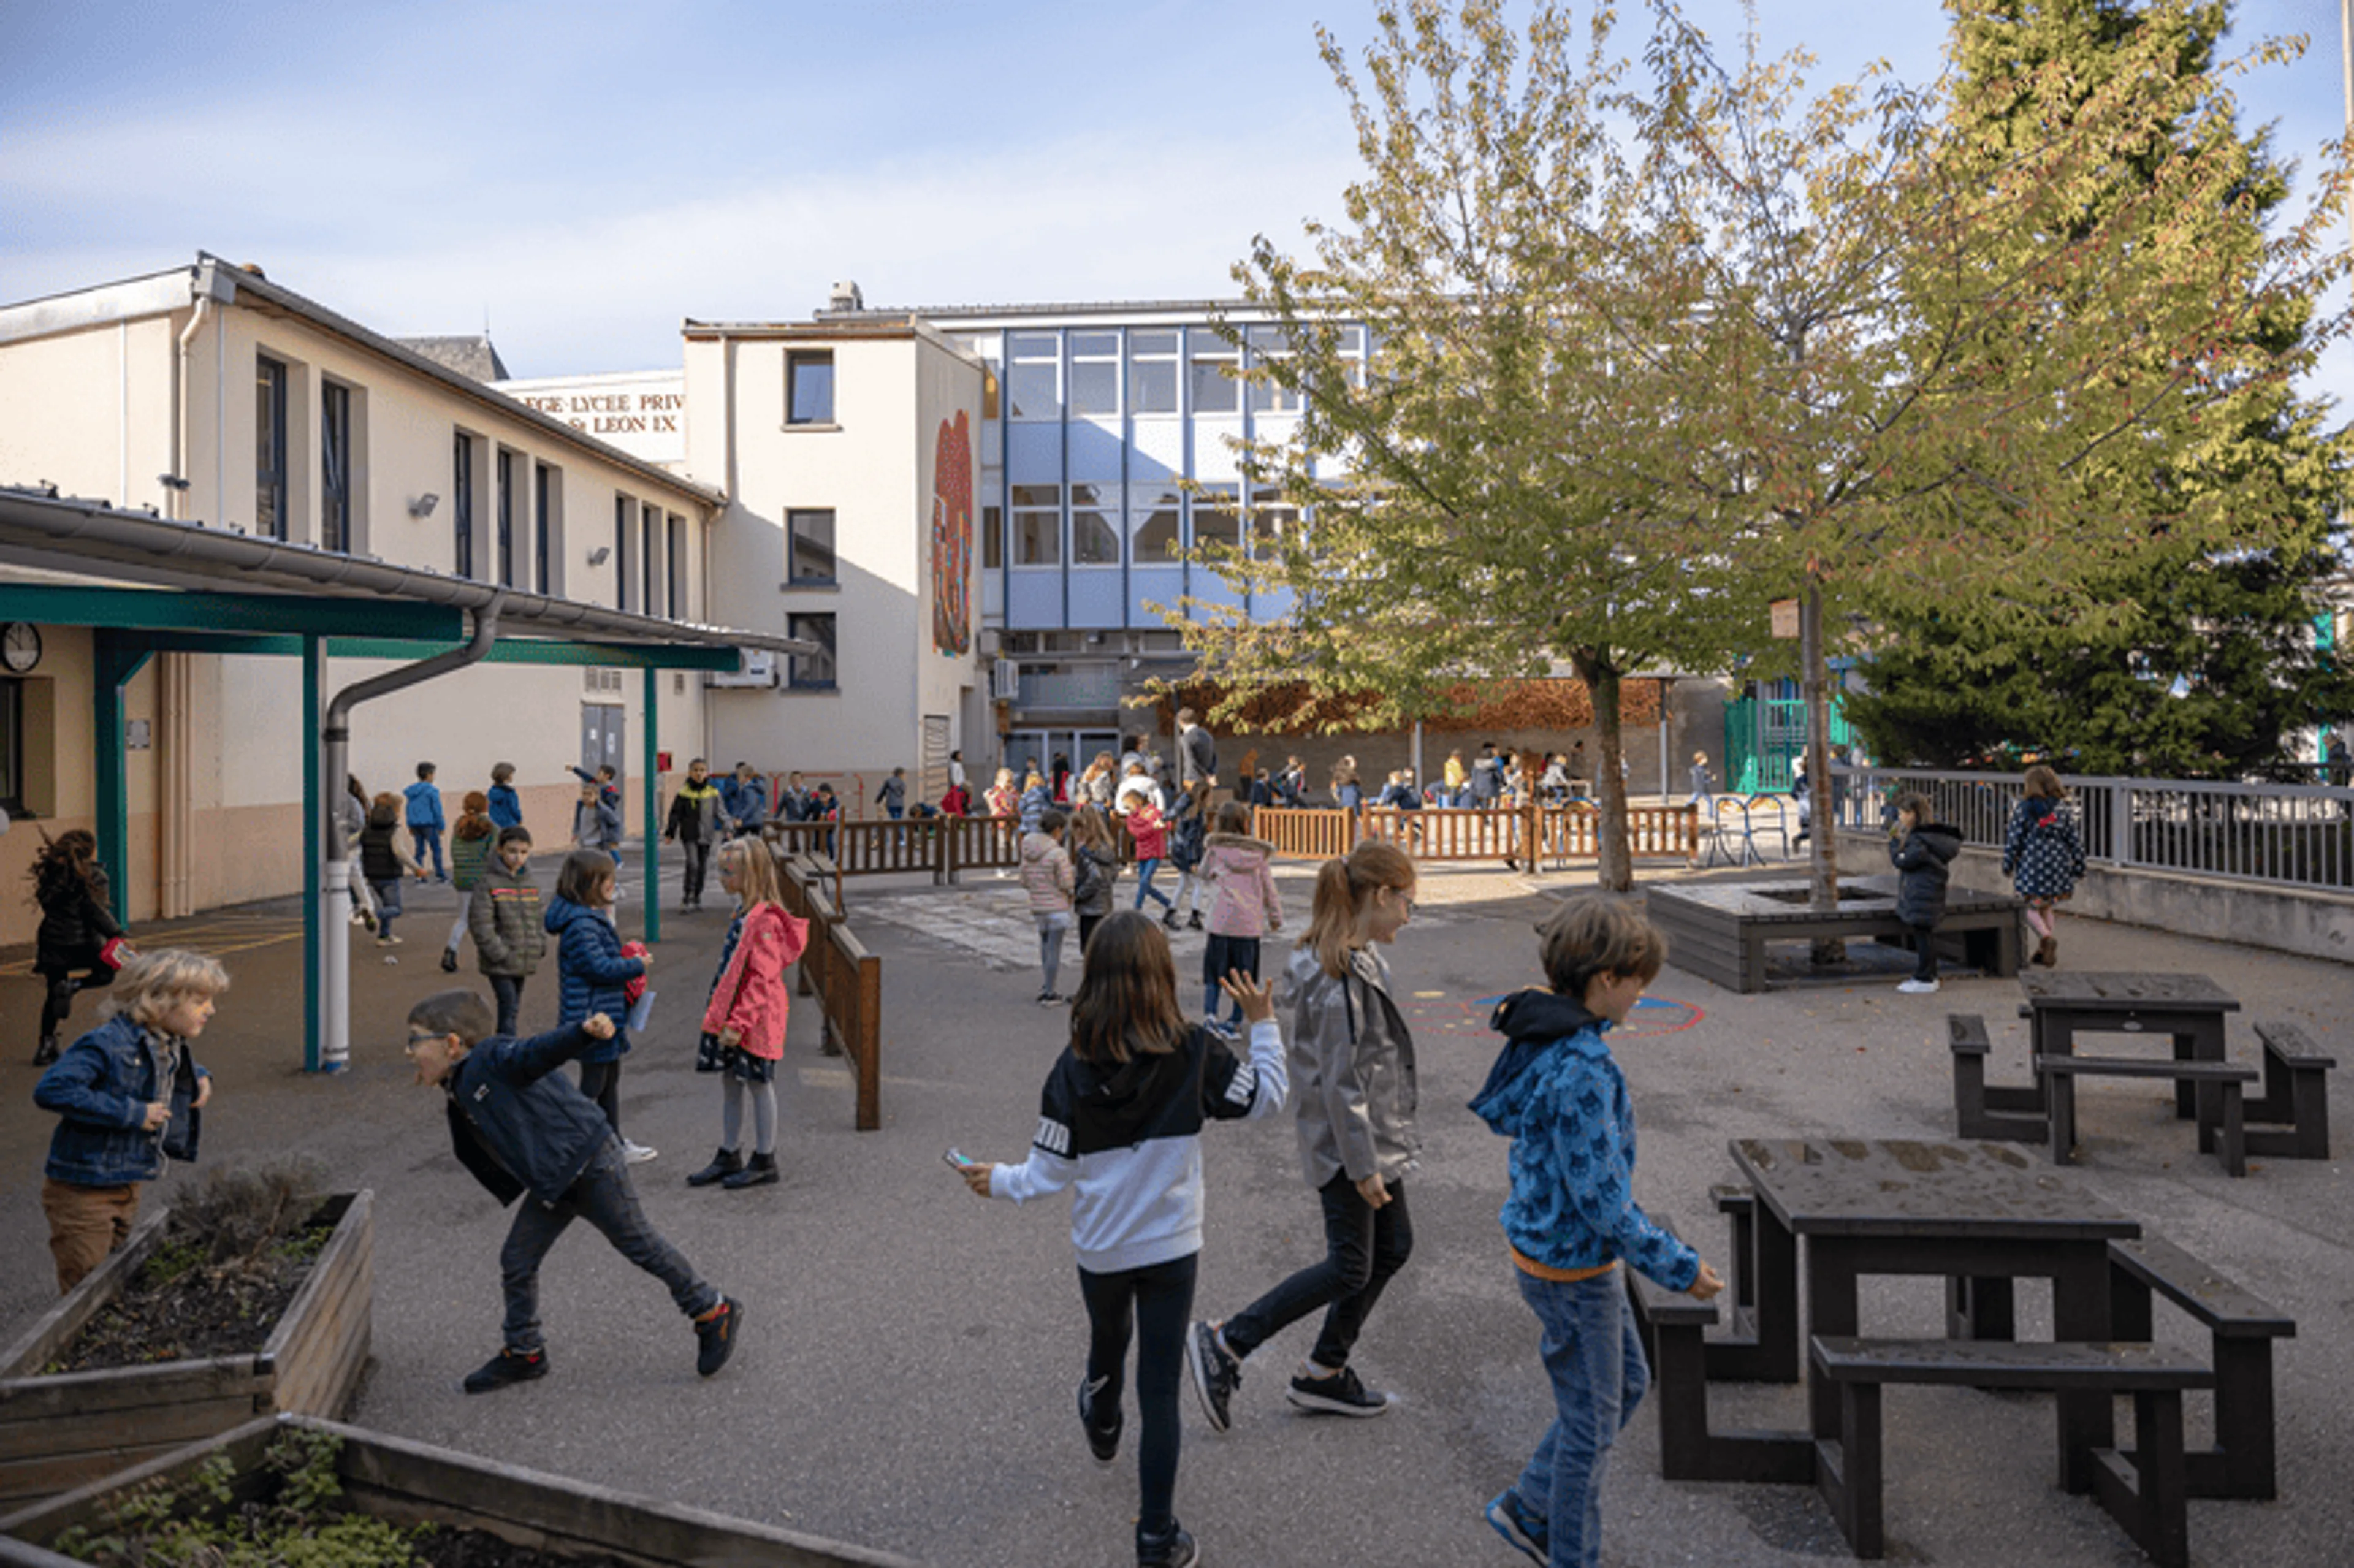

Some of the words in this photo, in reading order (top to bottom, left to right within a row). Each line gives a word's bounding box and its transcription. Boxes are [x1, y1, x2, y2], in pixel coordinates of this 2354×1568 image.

[571, 394, 631, 412] LYCEE
[593, 415, 646, 433] LEON
[653, 414, 677, 433] IX
